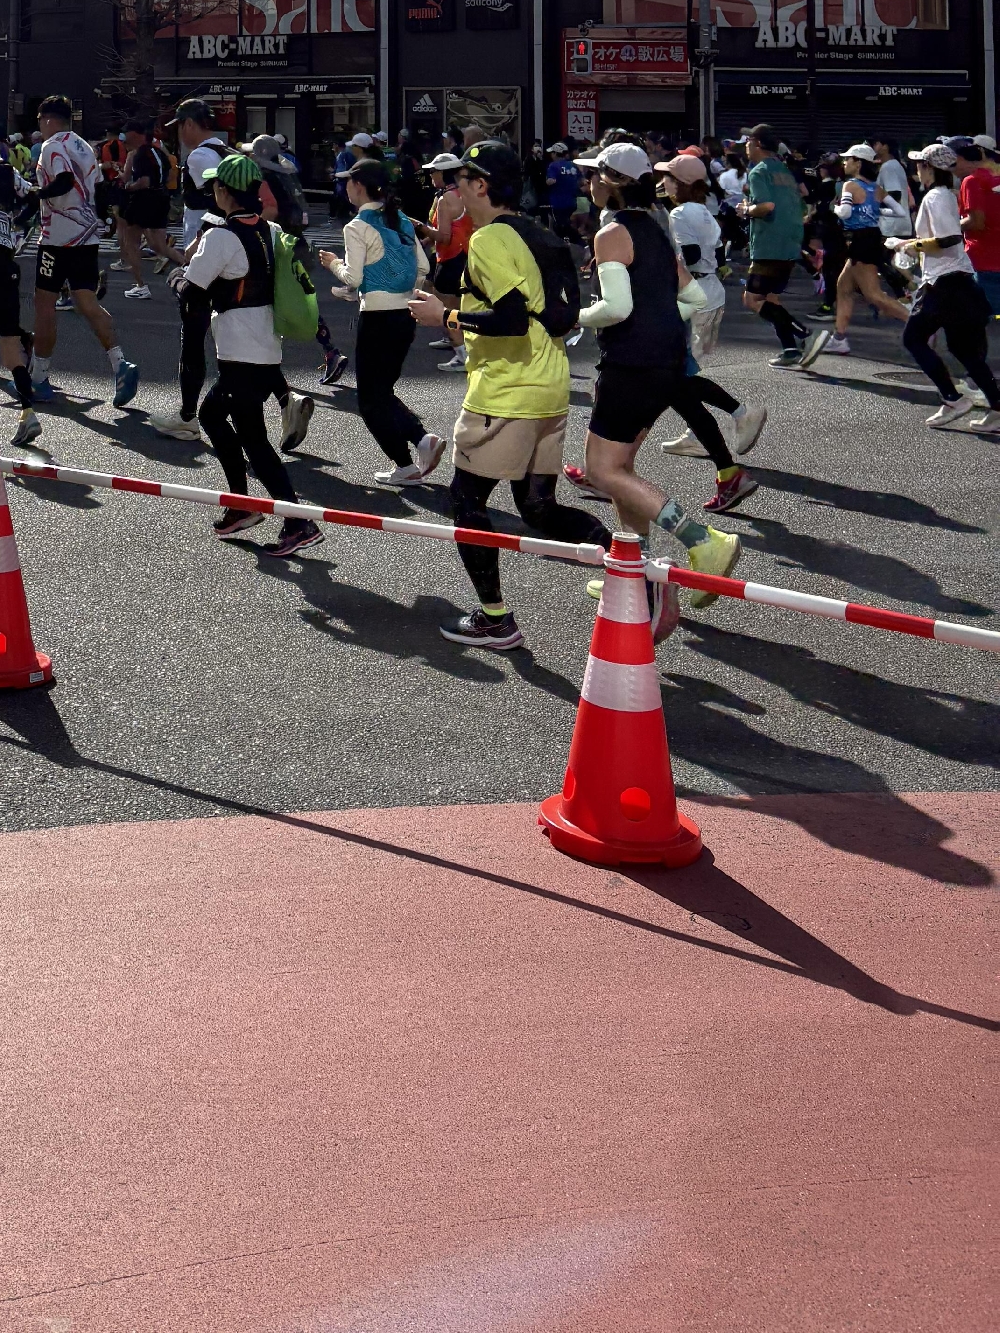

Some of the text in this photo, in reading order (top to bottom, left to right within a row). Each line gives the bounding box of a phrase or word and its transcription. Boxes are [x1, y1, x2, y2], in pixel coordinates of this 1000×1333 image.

[465, 0, 503, 8] saucony
[187, 35, 288, 59] ABC-MART
[637, 45, 685, 63] 歌広場
[829, 51, 854, 61] Stage
[293, 84, 329, 93] ABC-MART
[749, 85, 794, 95] ABC-MART
[878, 86, 923, 96] ABC-MART
[412, 105, 438, 113] adidas
[572, 115, 592, 124] 入口
[569, 126, 594, 134] こちら
[39, 250, 56, 277] 247
